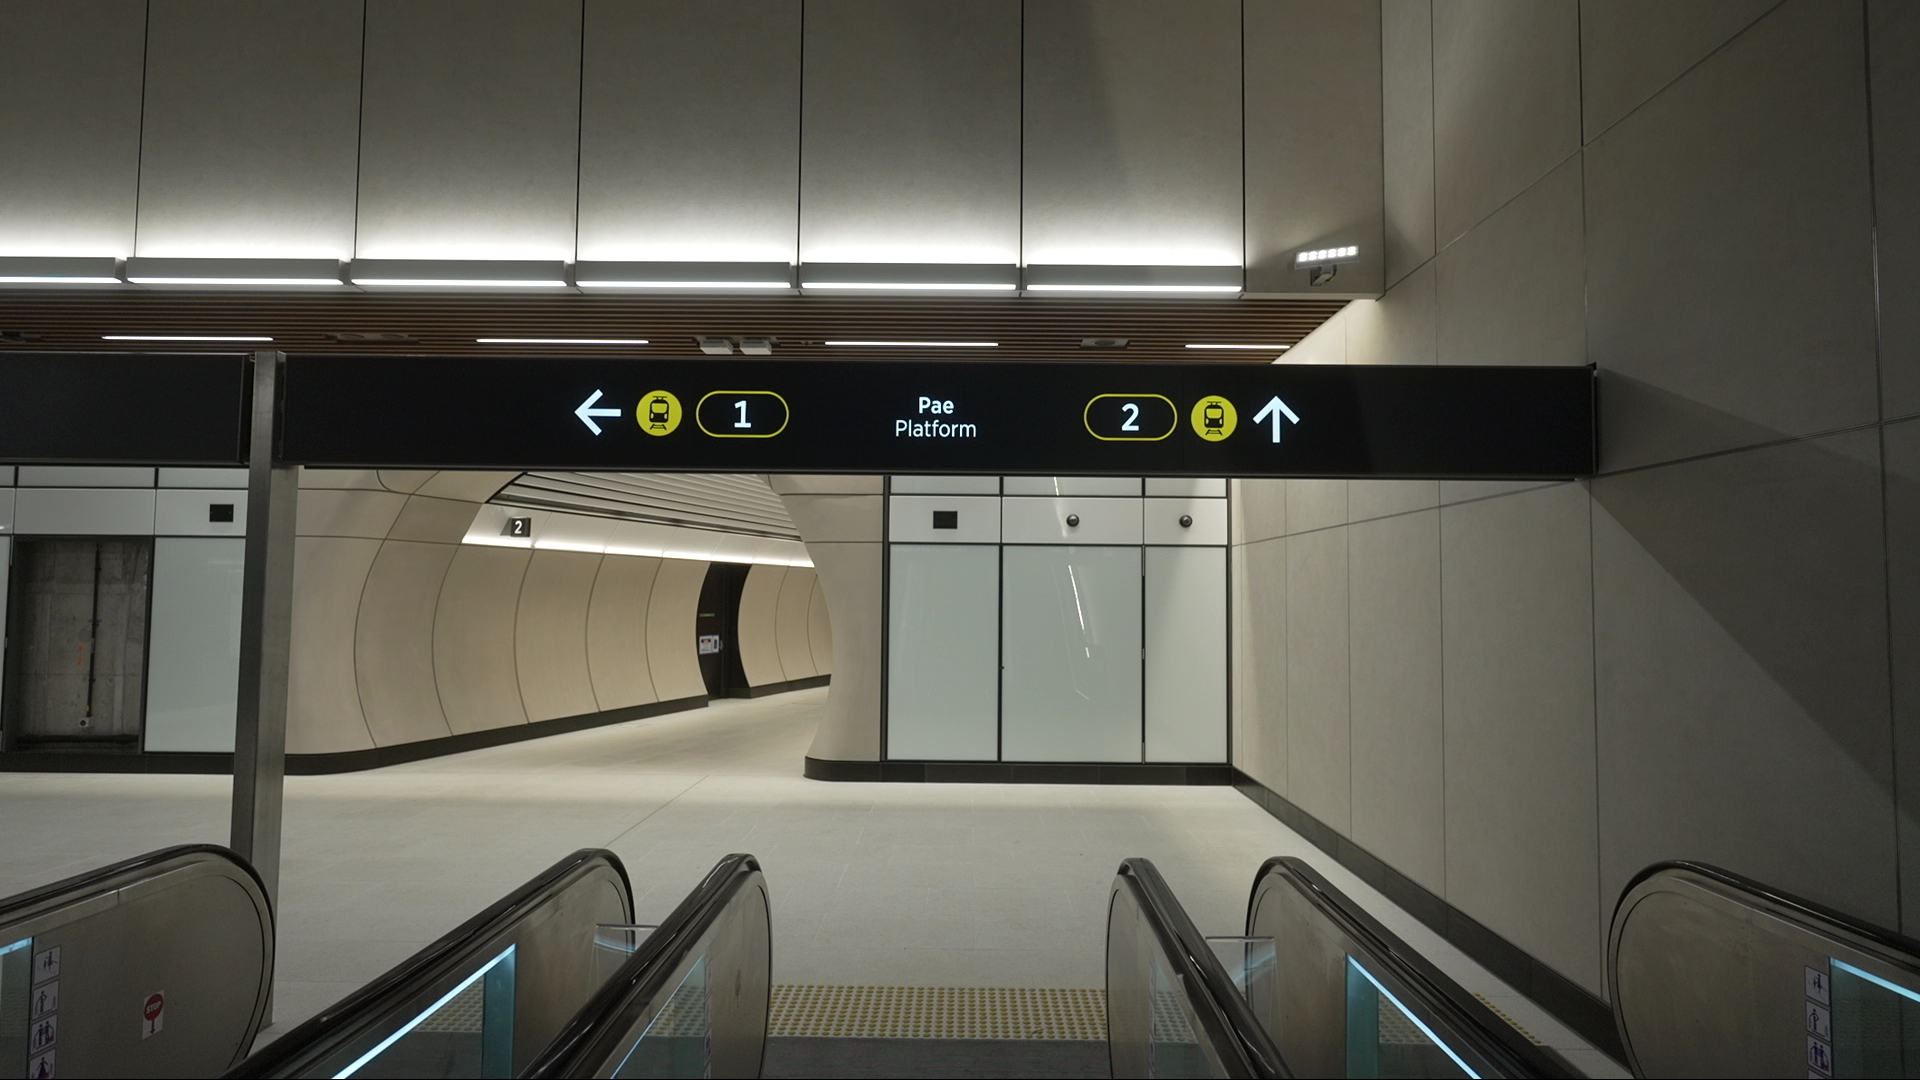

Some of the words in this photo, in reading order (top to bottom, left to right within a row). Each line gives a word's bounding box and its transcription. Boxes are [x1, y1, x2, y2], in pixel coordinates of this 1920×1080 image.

[734, 400, 752, 429] 1
[918, 396, 955, 415] Pae
[1121, 402, 1140, 432] 2
[895, 419, 977, 438] Platform
[514, 520, 523, 535] 2
[145, 1000, 162, 1014] STOP
